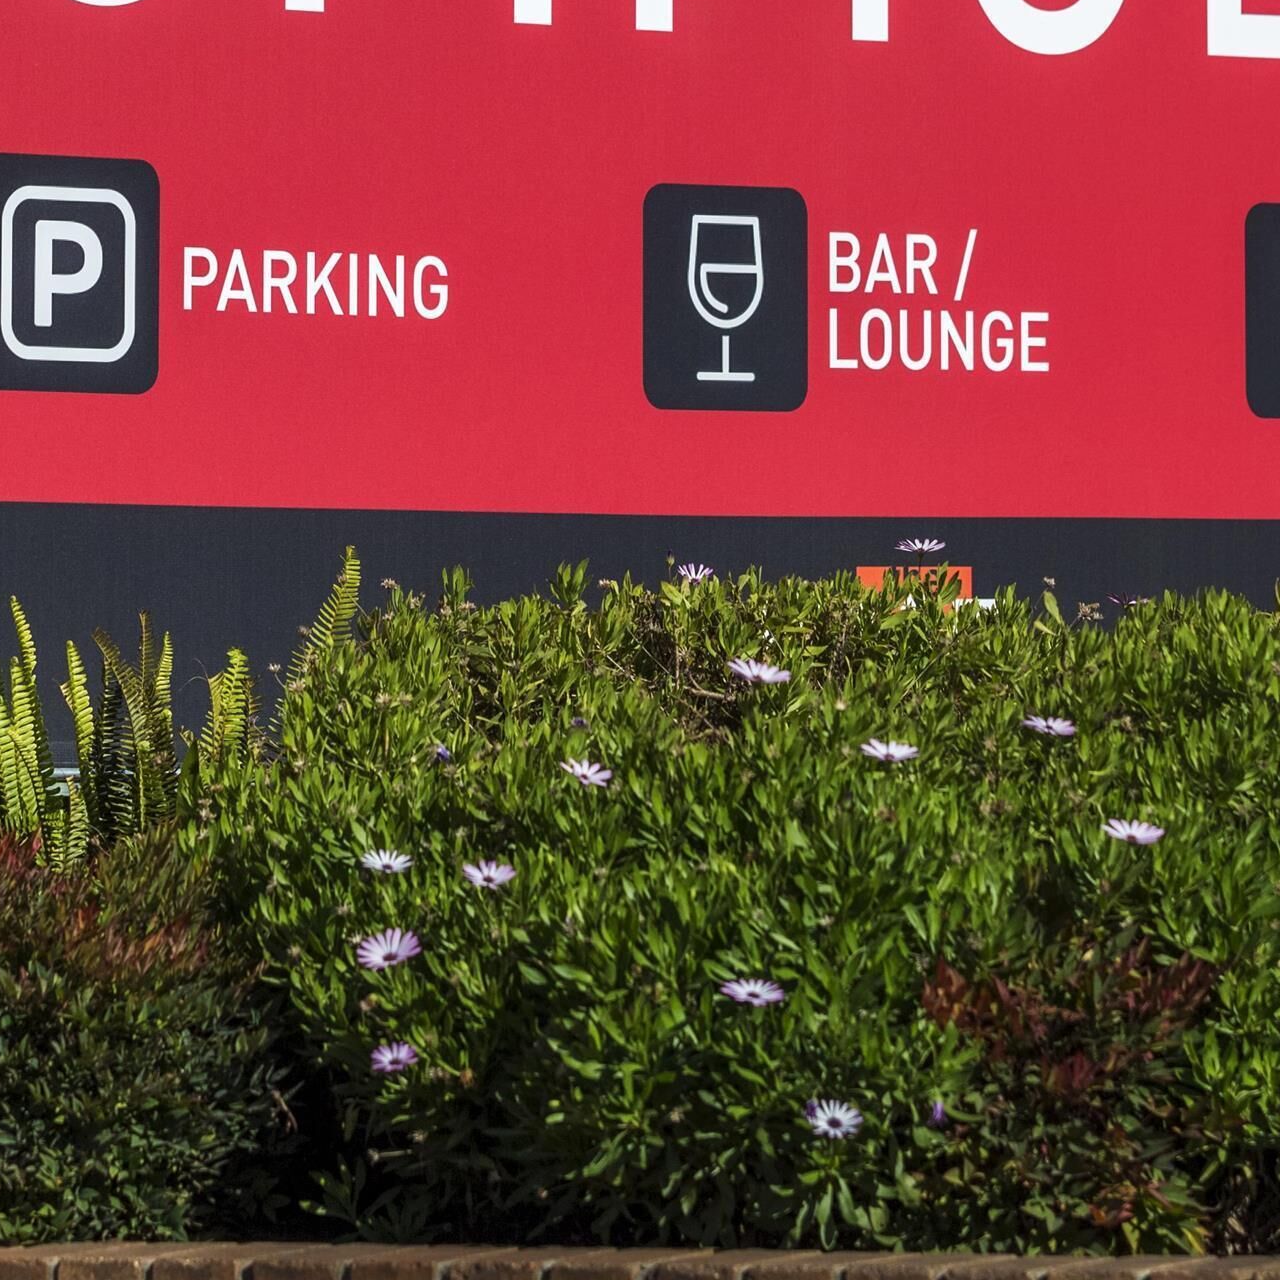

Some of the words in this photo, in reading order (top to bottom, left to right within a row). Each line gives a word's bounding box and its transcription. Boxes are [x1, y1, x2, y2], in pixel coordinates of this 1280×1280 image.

[182, 245, 450, 321] PARKING
[828, 231, 940, 296] BAR
[952, 228, 979, 302] /
[828, 307, 1051, 373] LOUNGE
